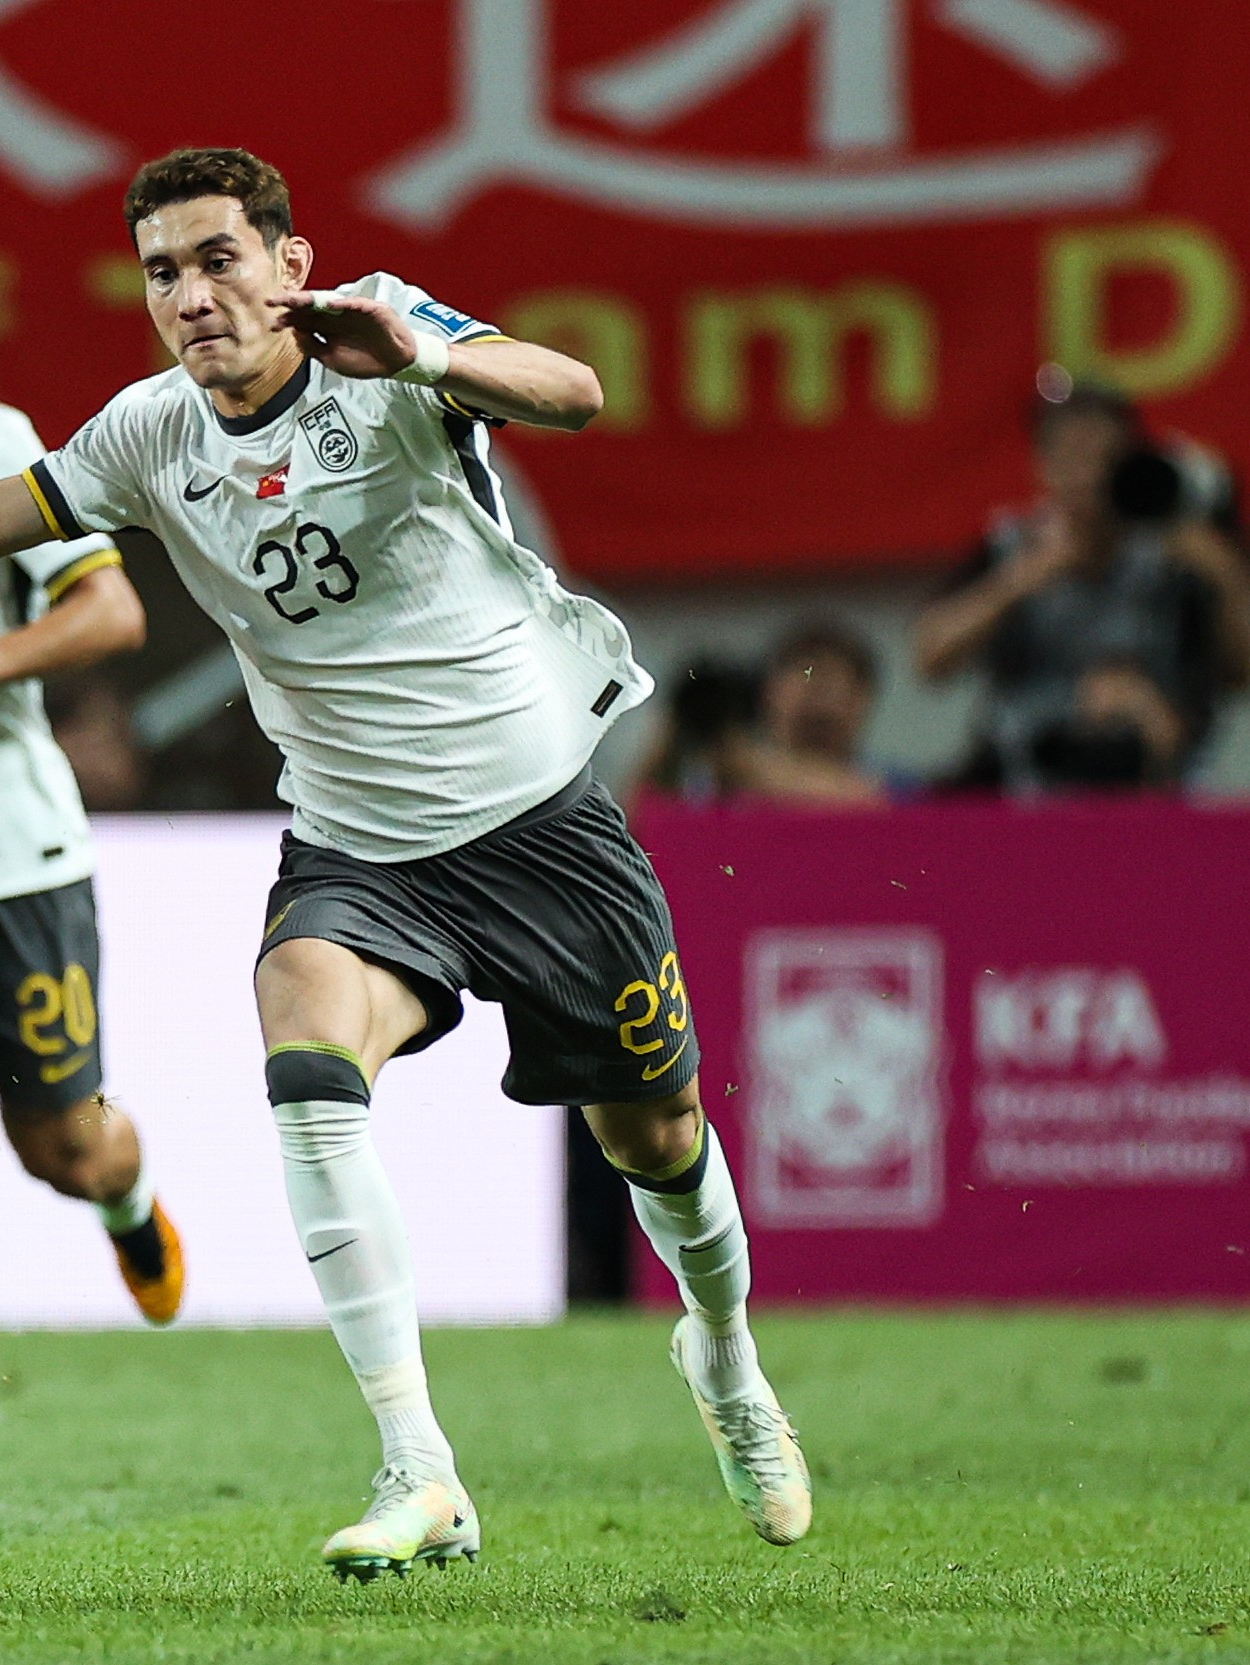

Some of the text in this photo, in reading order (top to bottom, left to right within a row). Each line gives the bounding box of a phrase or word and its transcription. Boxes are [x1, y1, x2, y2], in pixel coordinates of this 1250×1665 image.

[303, 402, 338, 432] CFA
[253, 522, 360, 624] 23
[15, 962, 97, 1056] 20
[615, 951, 688, 1055] 23
